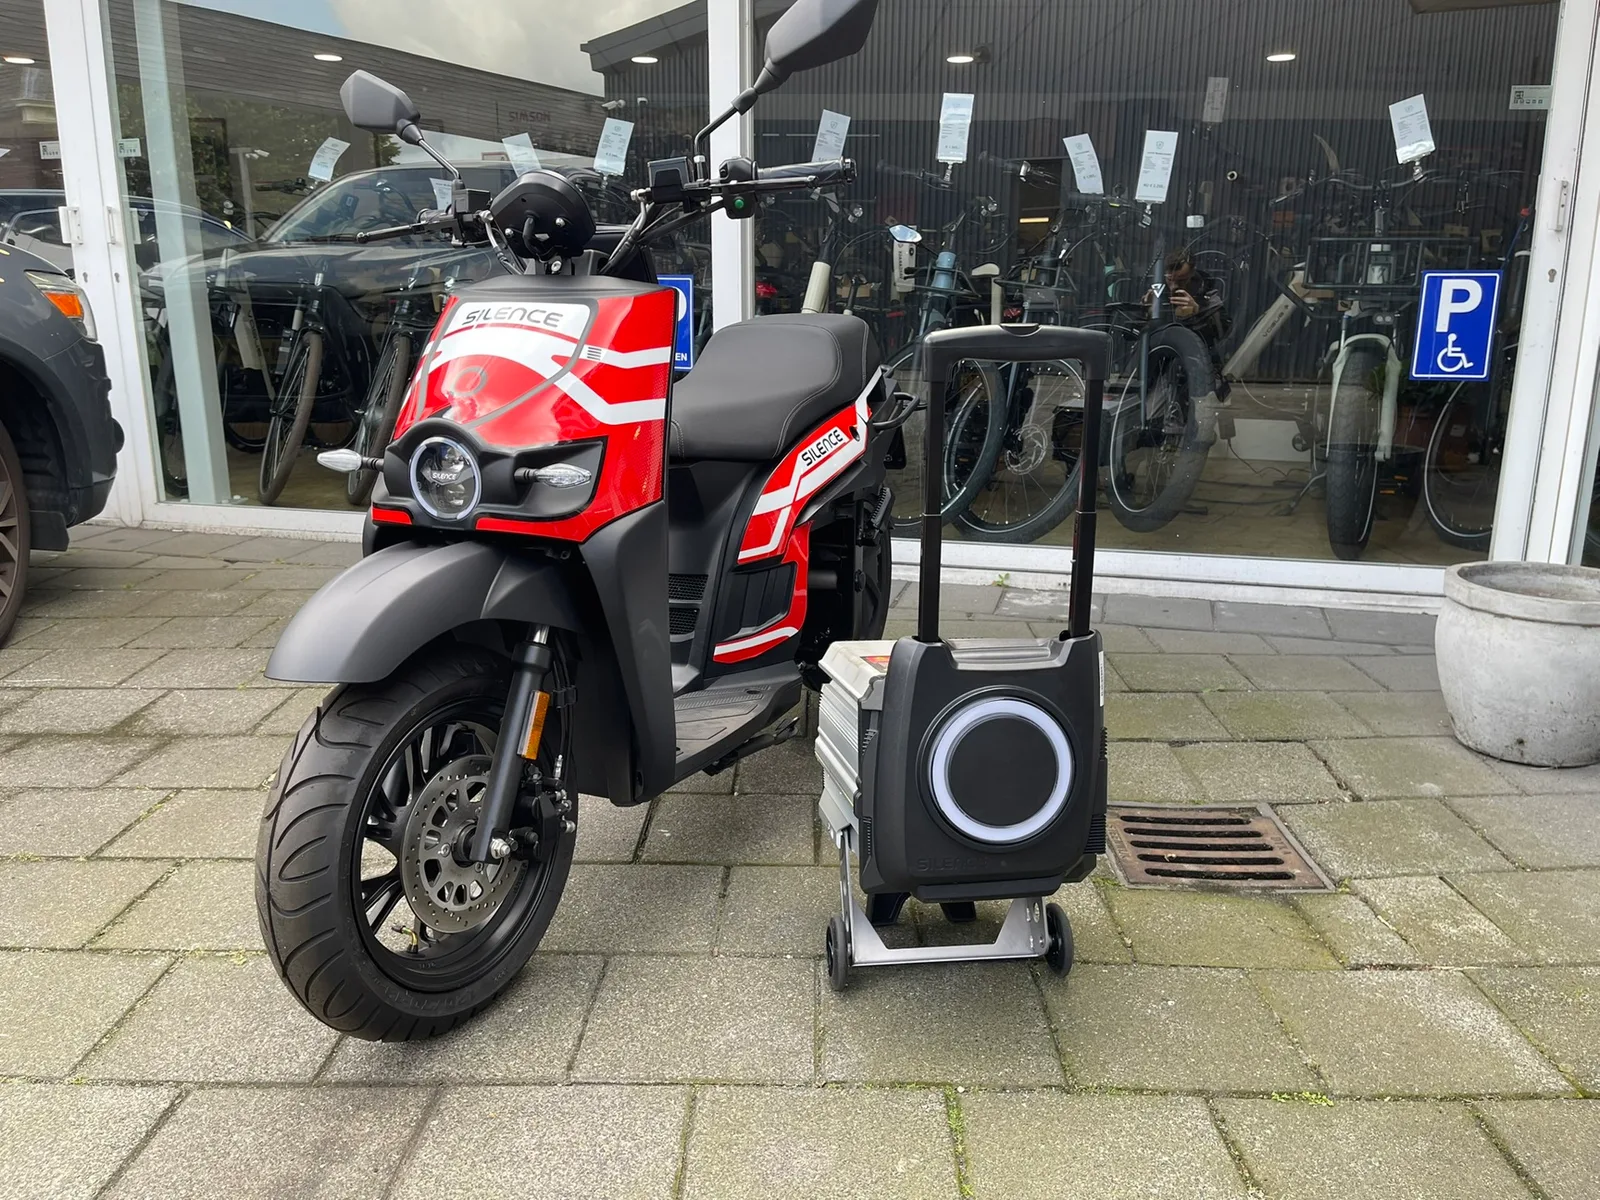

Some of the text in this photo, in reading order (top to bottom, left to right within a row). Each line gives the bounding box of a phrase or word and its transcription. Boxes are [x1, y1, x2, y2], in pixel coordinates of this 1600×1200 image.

[462, 307, 564, 328] SILENCE
[1436, 279, 1482, 332] P
[801, 429, 844, 467] SILENCE
[432, 472, 458, 480] SILENCE
